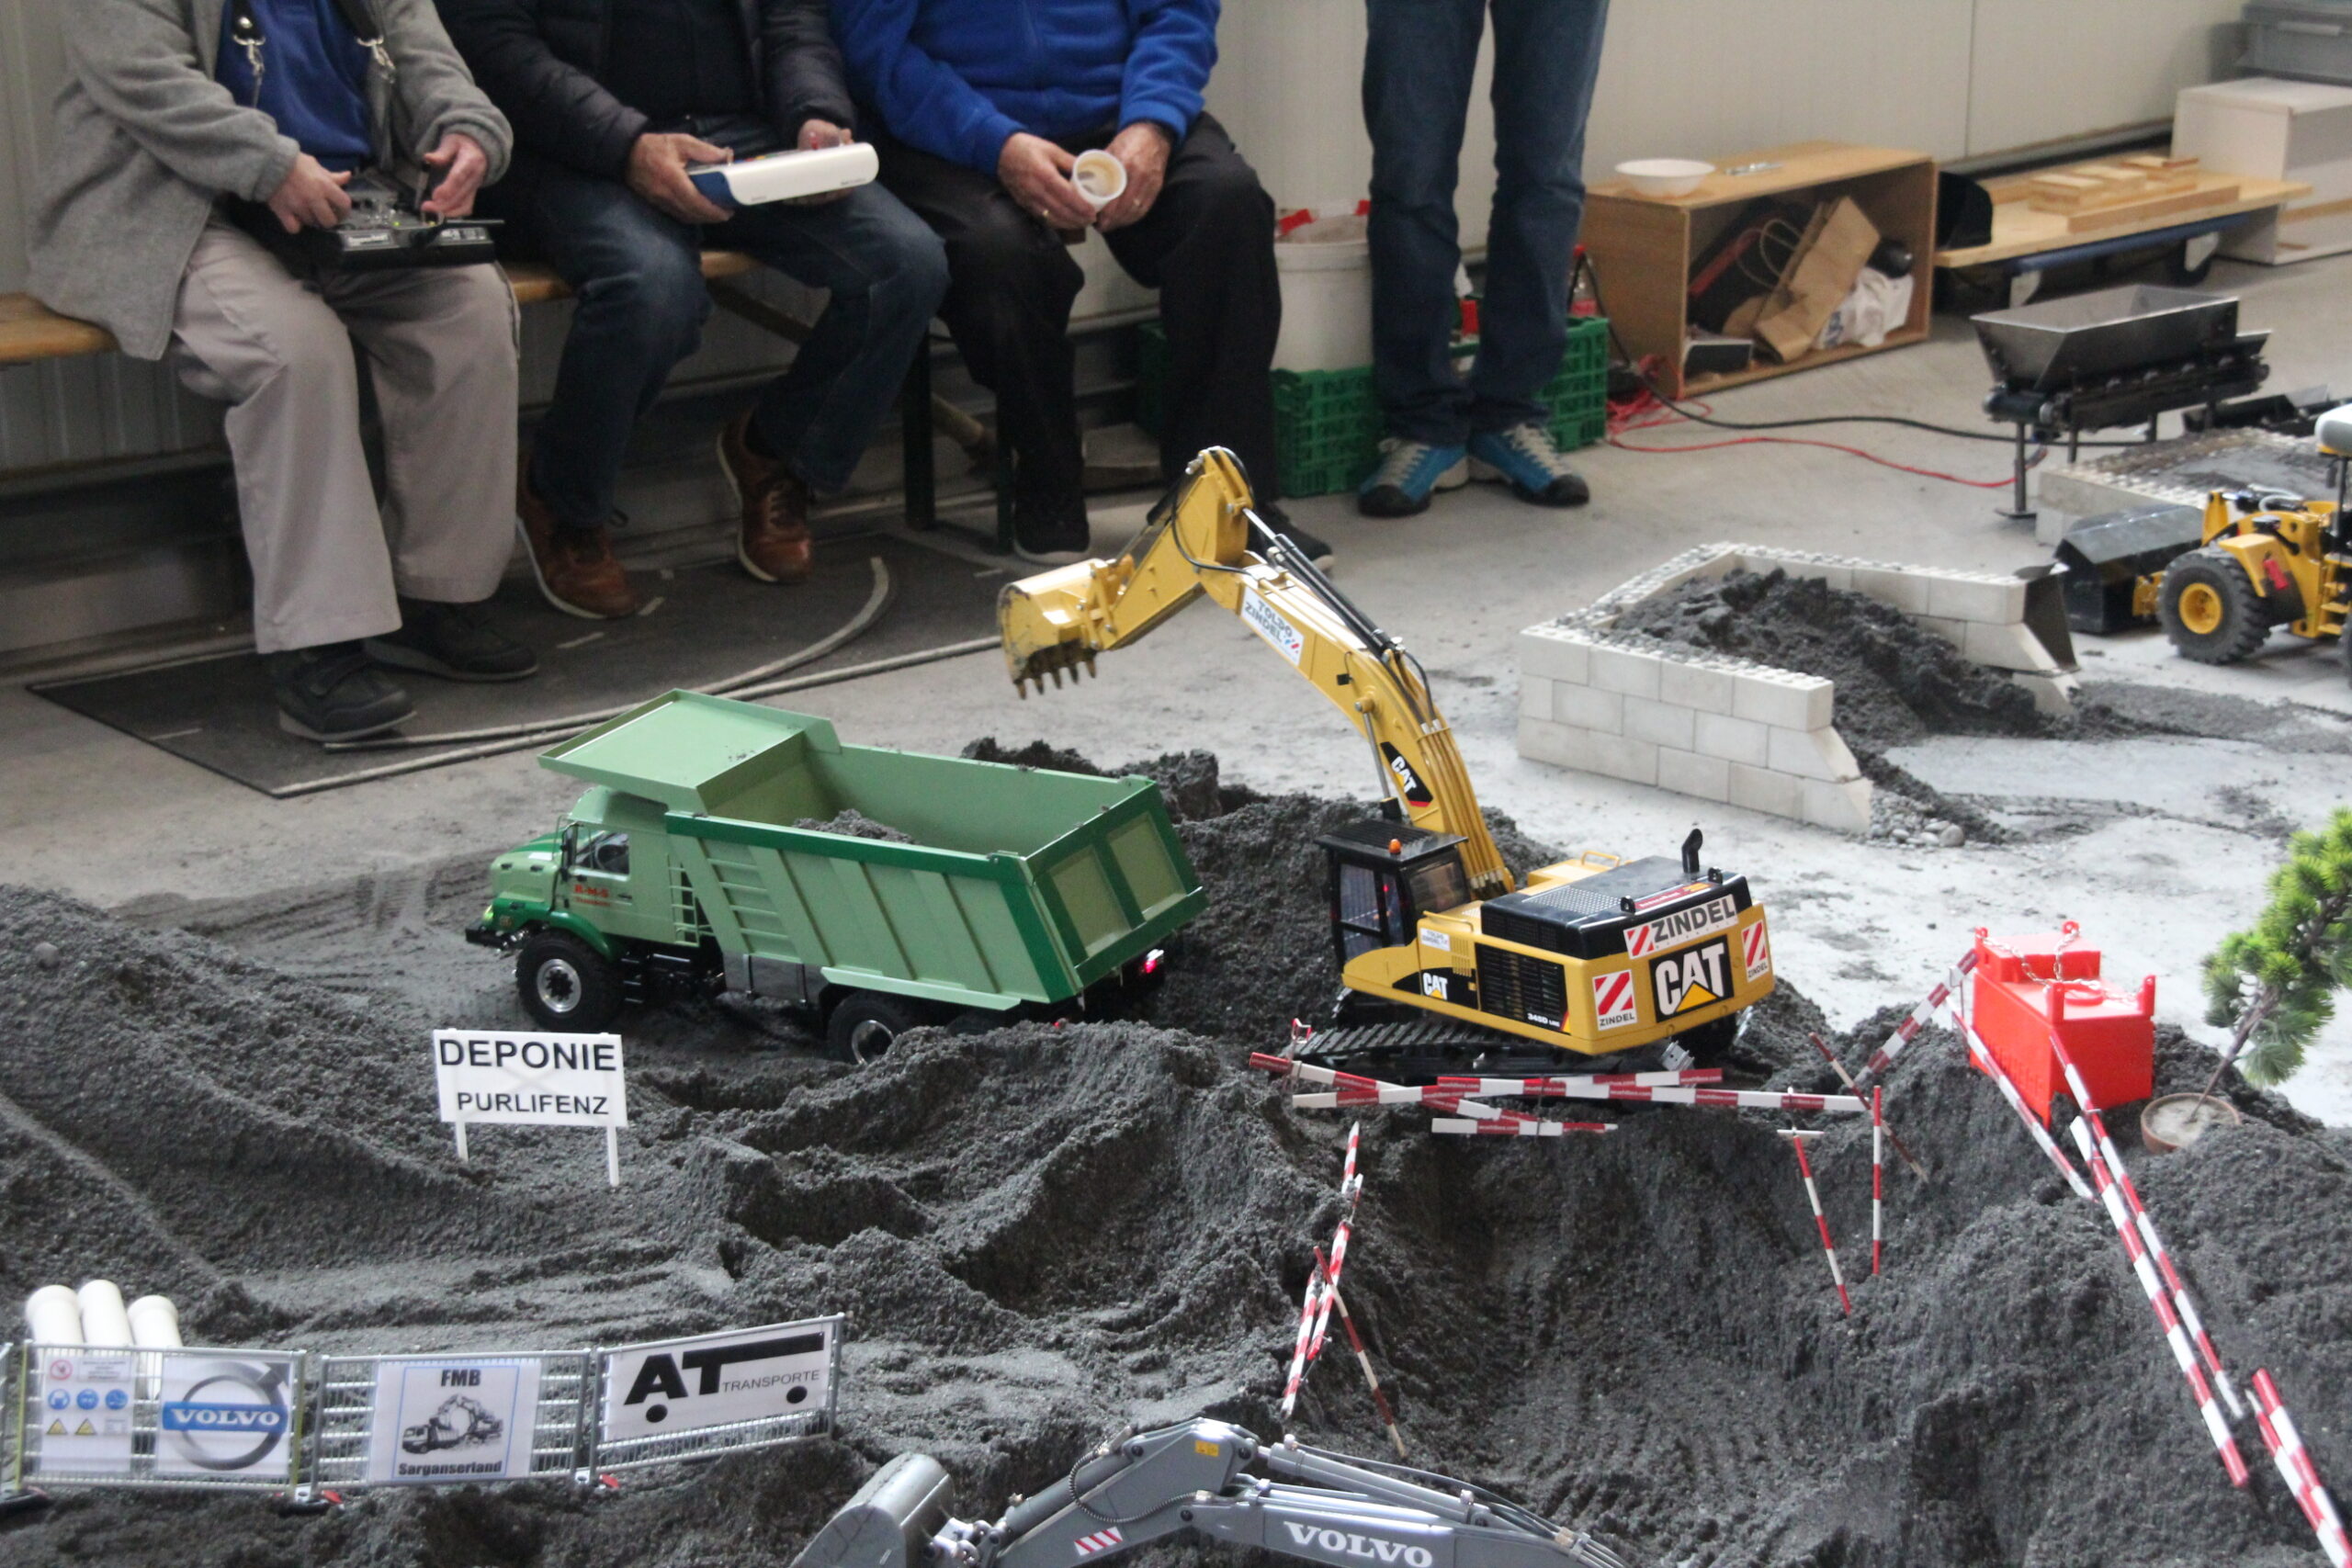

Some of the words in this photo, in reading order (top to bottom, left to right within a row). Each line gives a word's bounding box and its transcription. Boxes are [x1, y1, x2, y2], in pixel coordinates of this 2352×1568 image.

[1245, 603, 1283, 642] ZINDEL
[1391, 756, 1417, 794] CAT
[1651, 897, 1736, 942] ZINDEL
[1655, 942, 1725, 1016] CAT
[1747, 963, 1769, 978] ZINDEL
[1422, 973, 1448, 1000] CAT
[1600, 1013, 1635, 1028] ZINDEL
[439, 1038, 616, 1071] DEPONIE
[458, 1092, 609, 1115] PURLIFENZ
[441, 1369, 481, 1387] FMB
[722, 1370, 820, 1392] TRANSPORTE
[171, 1408, 280, 1426] VOLVO
[399, 1461, 502, 1477] Sarganserland
[1283, 1520, 1433, 1568] VOLVO
